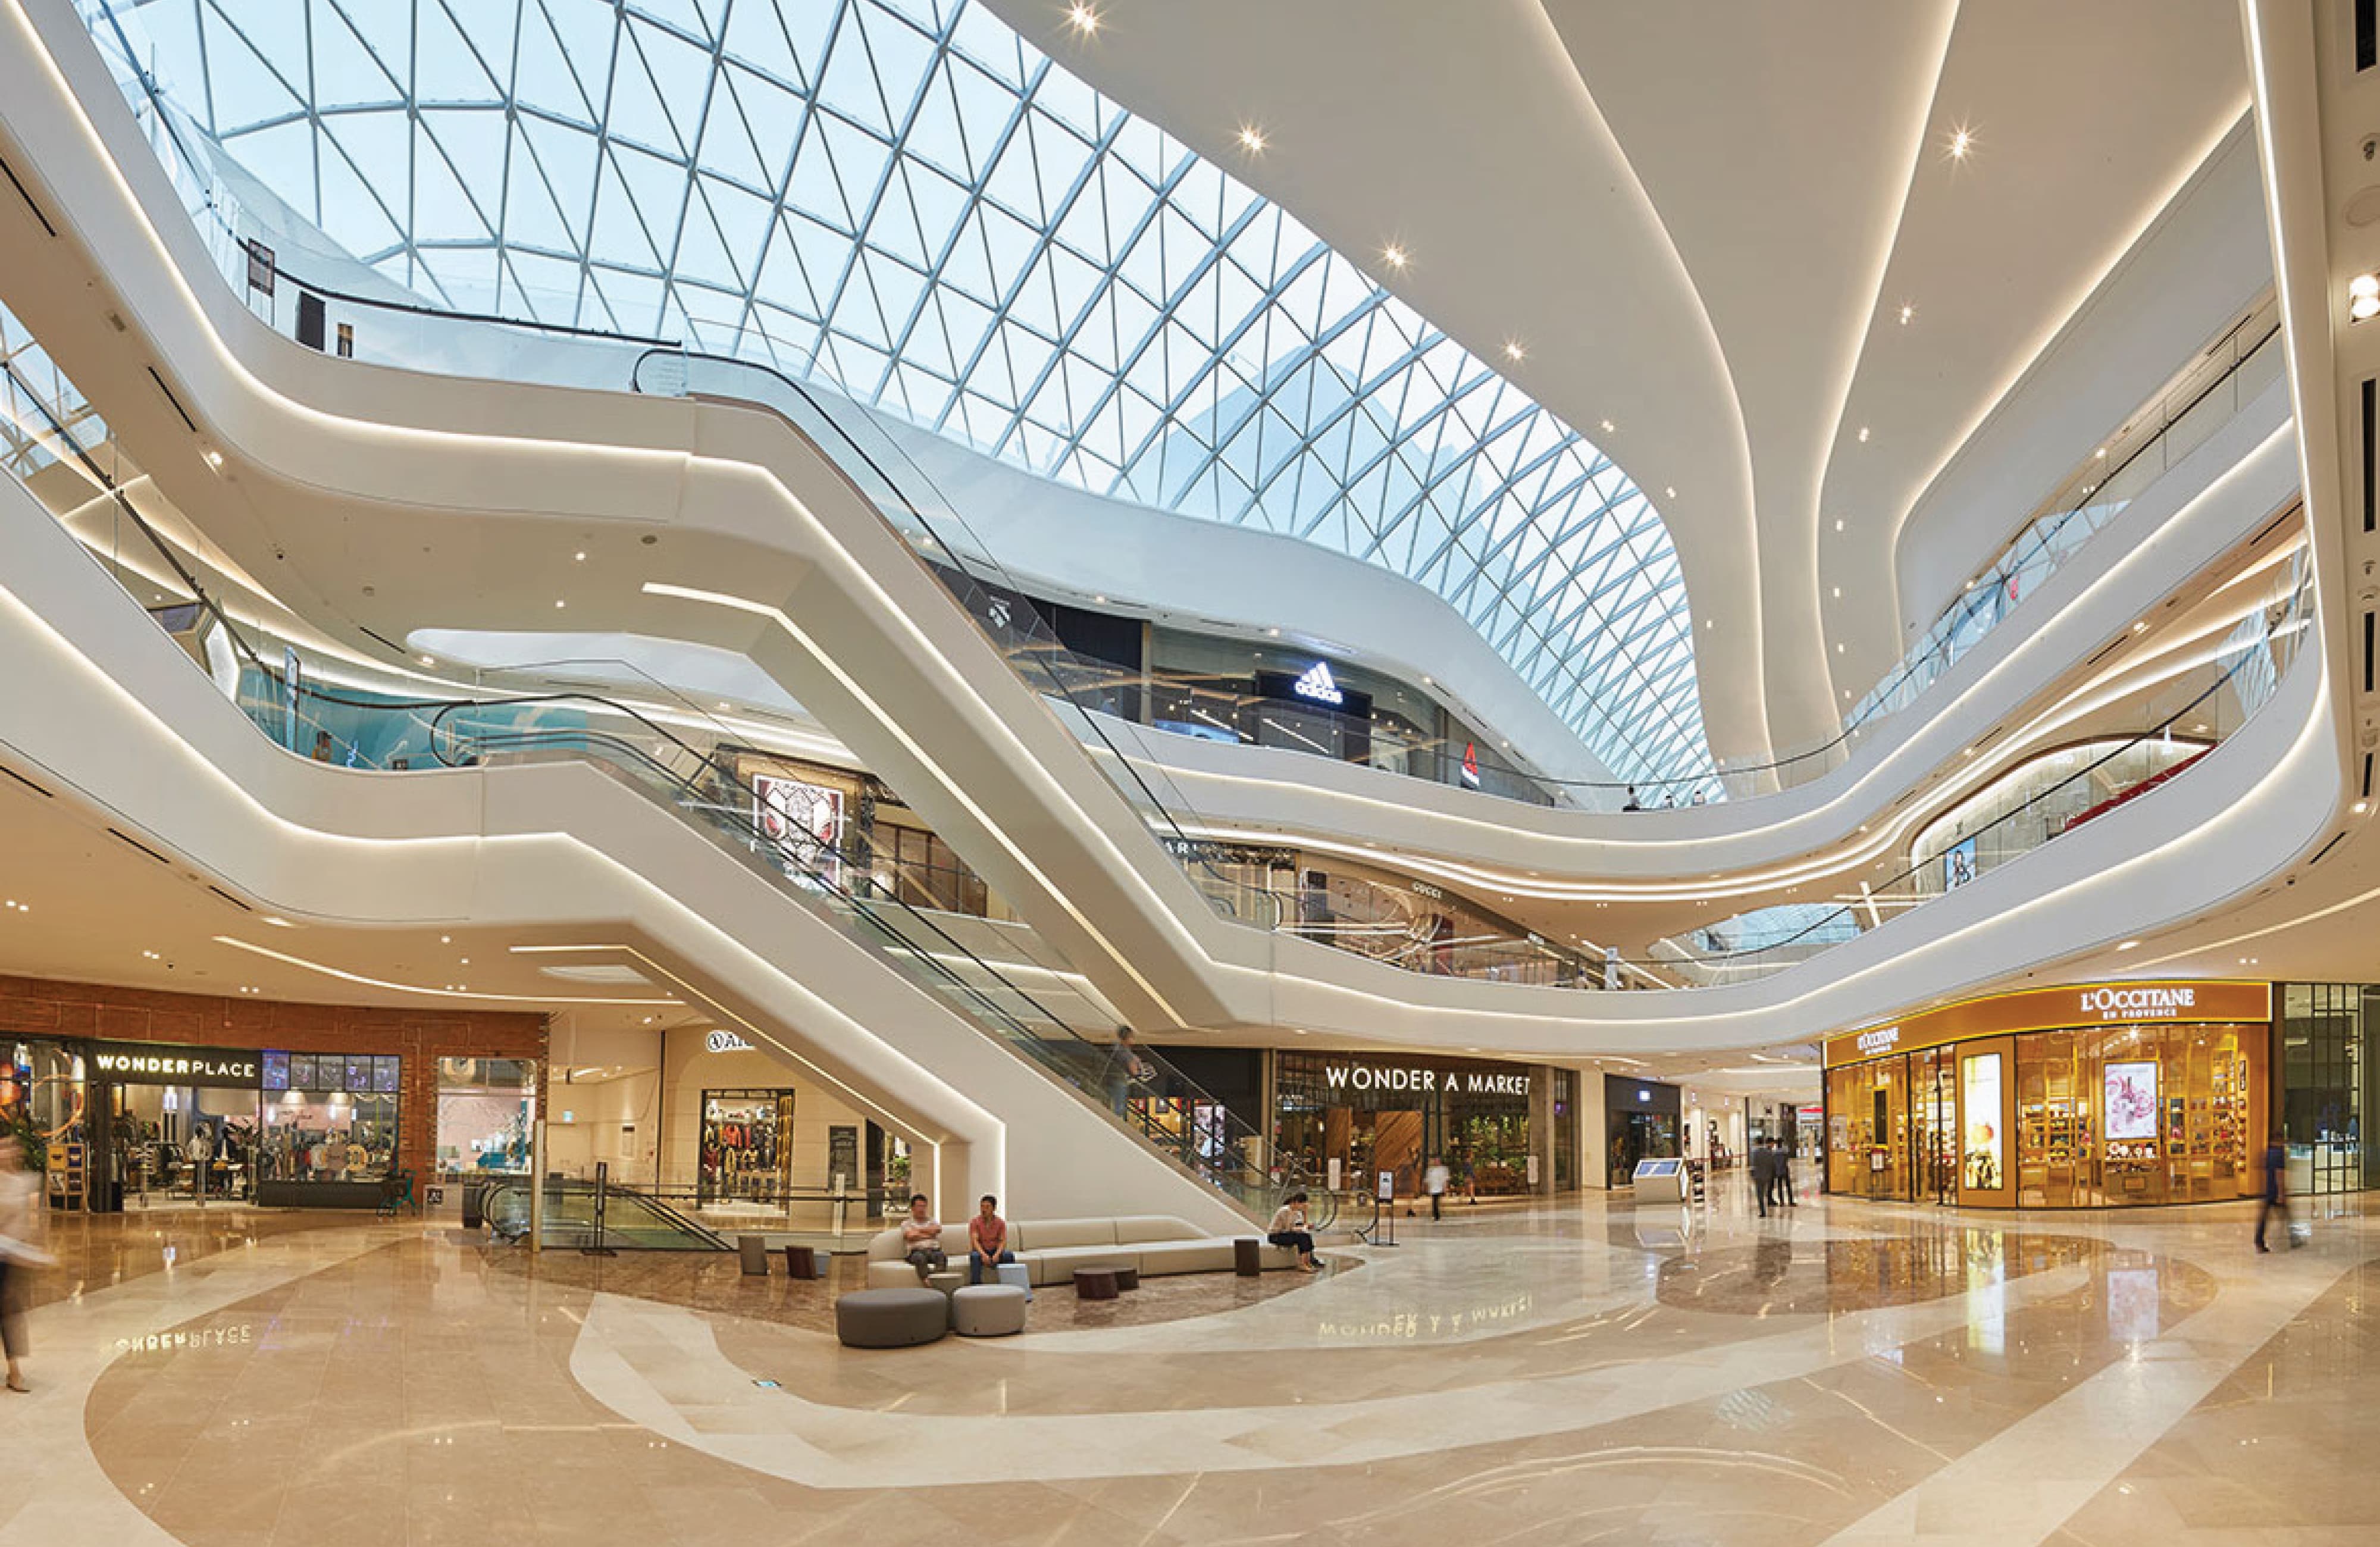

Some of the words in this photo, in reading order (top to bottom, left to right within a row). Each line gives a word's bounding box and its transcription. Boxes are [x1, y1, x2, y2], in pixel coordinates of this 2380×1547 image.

[1295, 682, 1343, 704] adidas
[2081, 988, 2196, 1012] L'OCCITANE
[96, 1054, 255, 1077] WONDERPLACE
[1326, 1066, 1435, 1089] WONDER
[1444, 1072, 1459, 1091] A
[1468, 1074, 1530, 1095] MARKET
